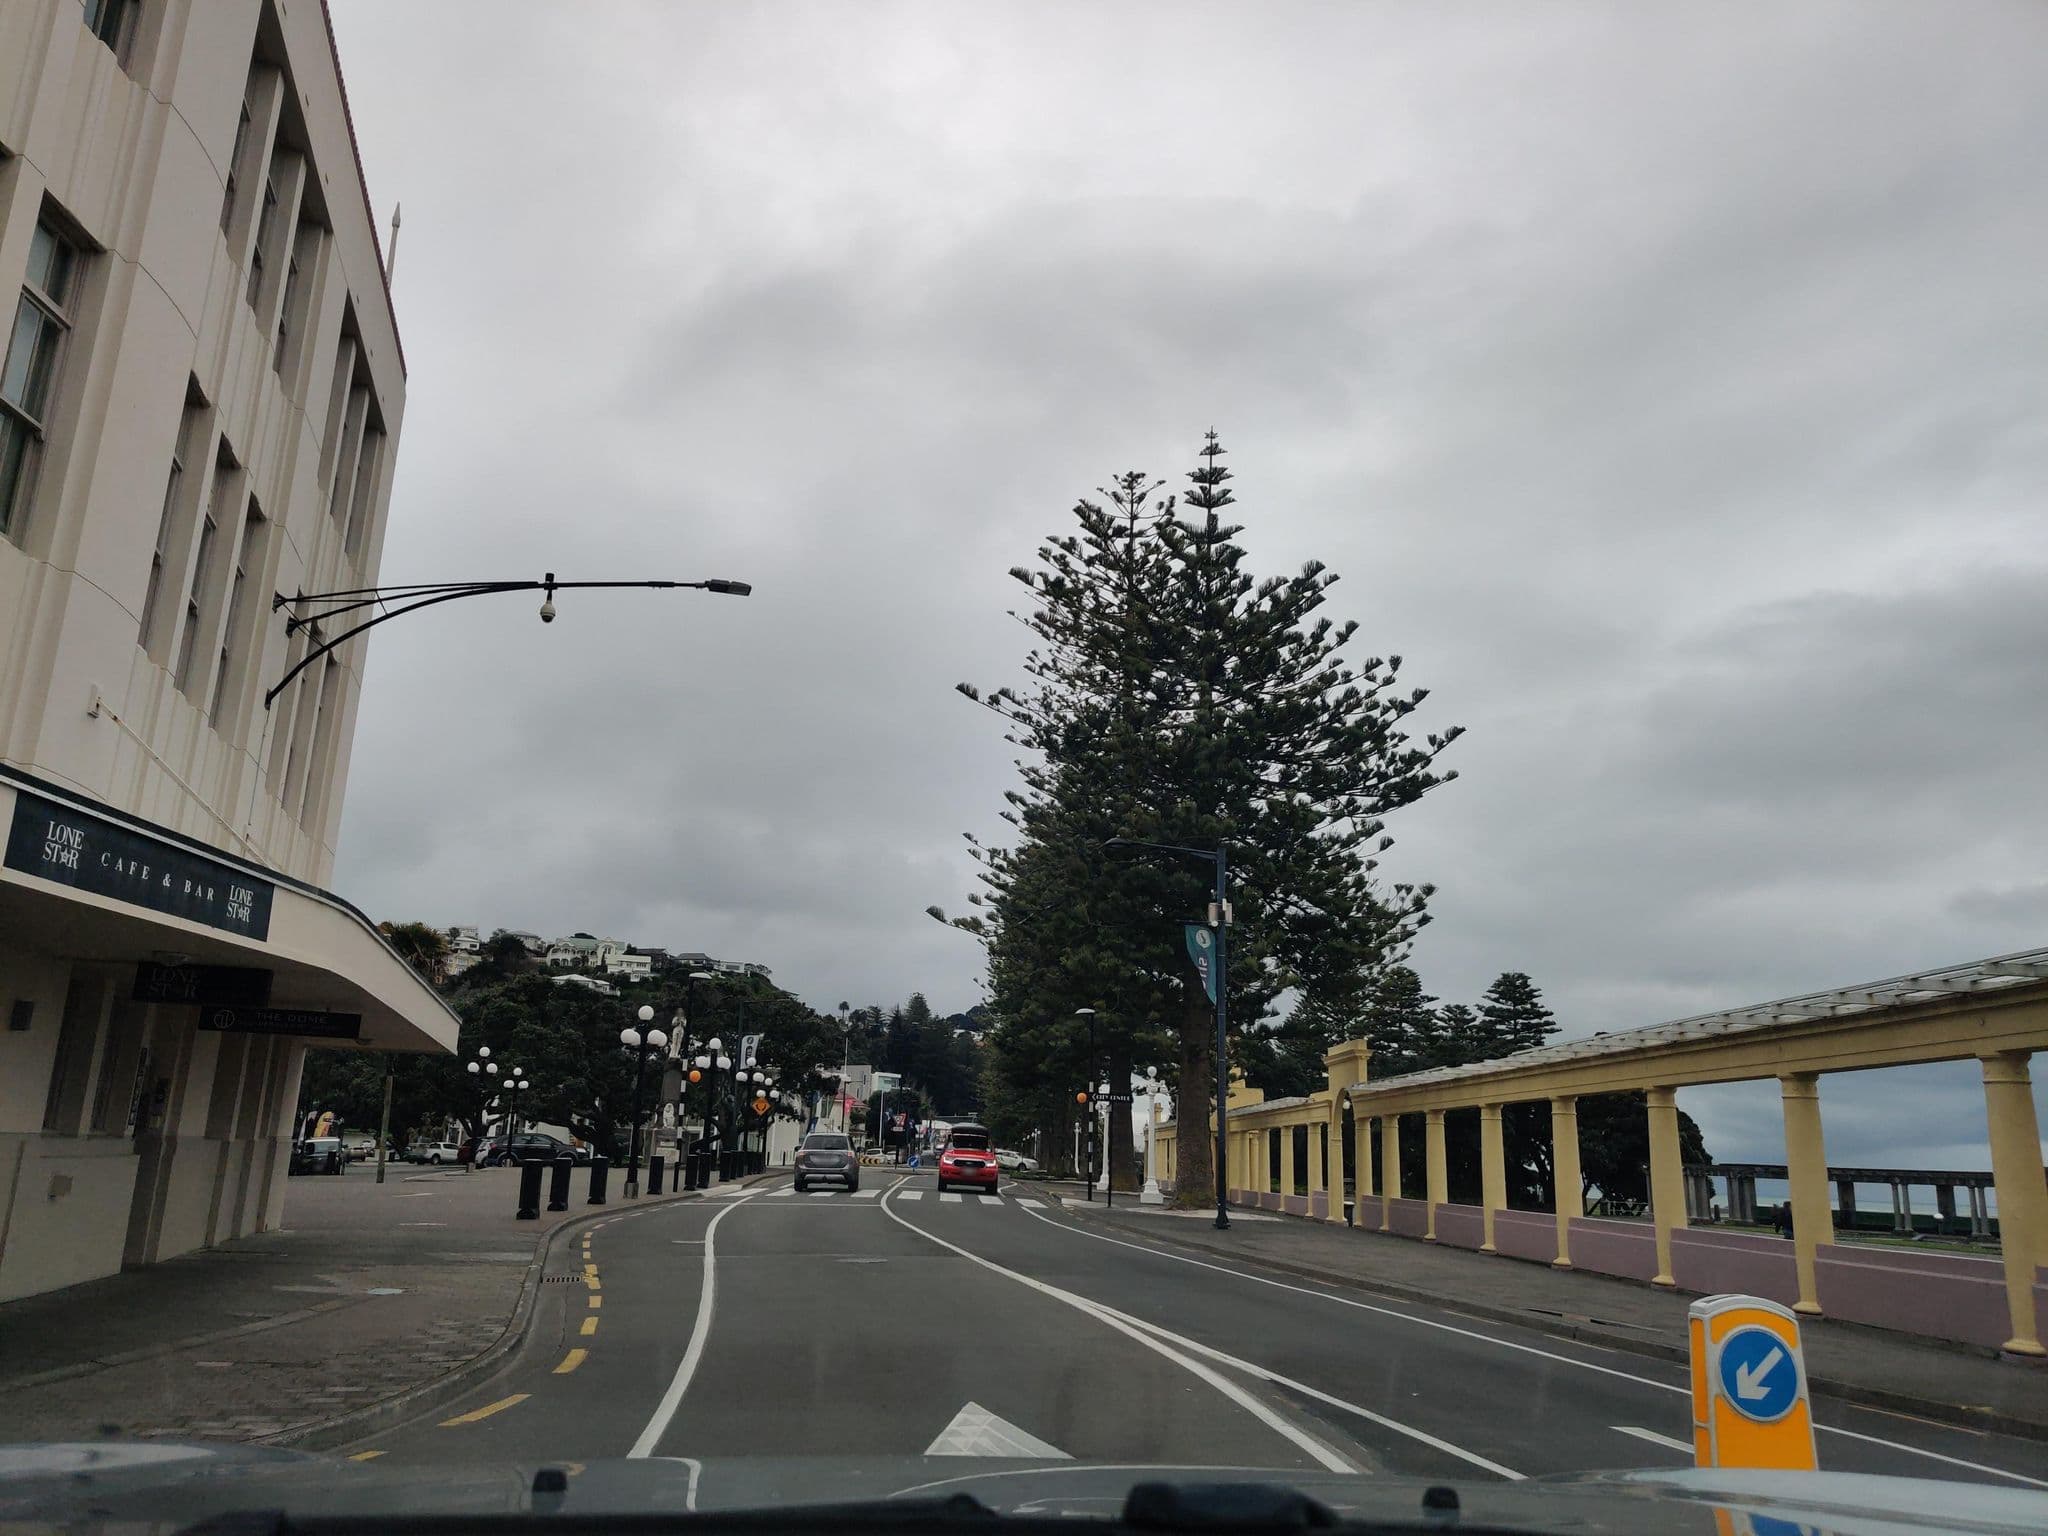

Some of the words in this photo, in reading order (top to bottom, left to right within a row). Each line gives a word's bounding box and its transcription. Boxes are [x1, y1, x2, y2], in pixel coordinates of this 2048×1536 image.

[47, 821, 84, 850] LONE
[101, 852, 150, 880] CAFE
[163, 873, 172, 887] &
[184, 879, 214, 901] BAR
[229, 884, 254, 907] LONE
[148, 982, 197, 999] STR
